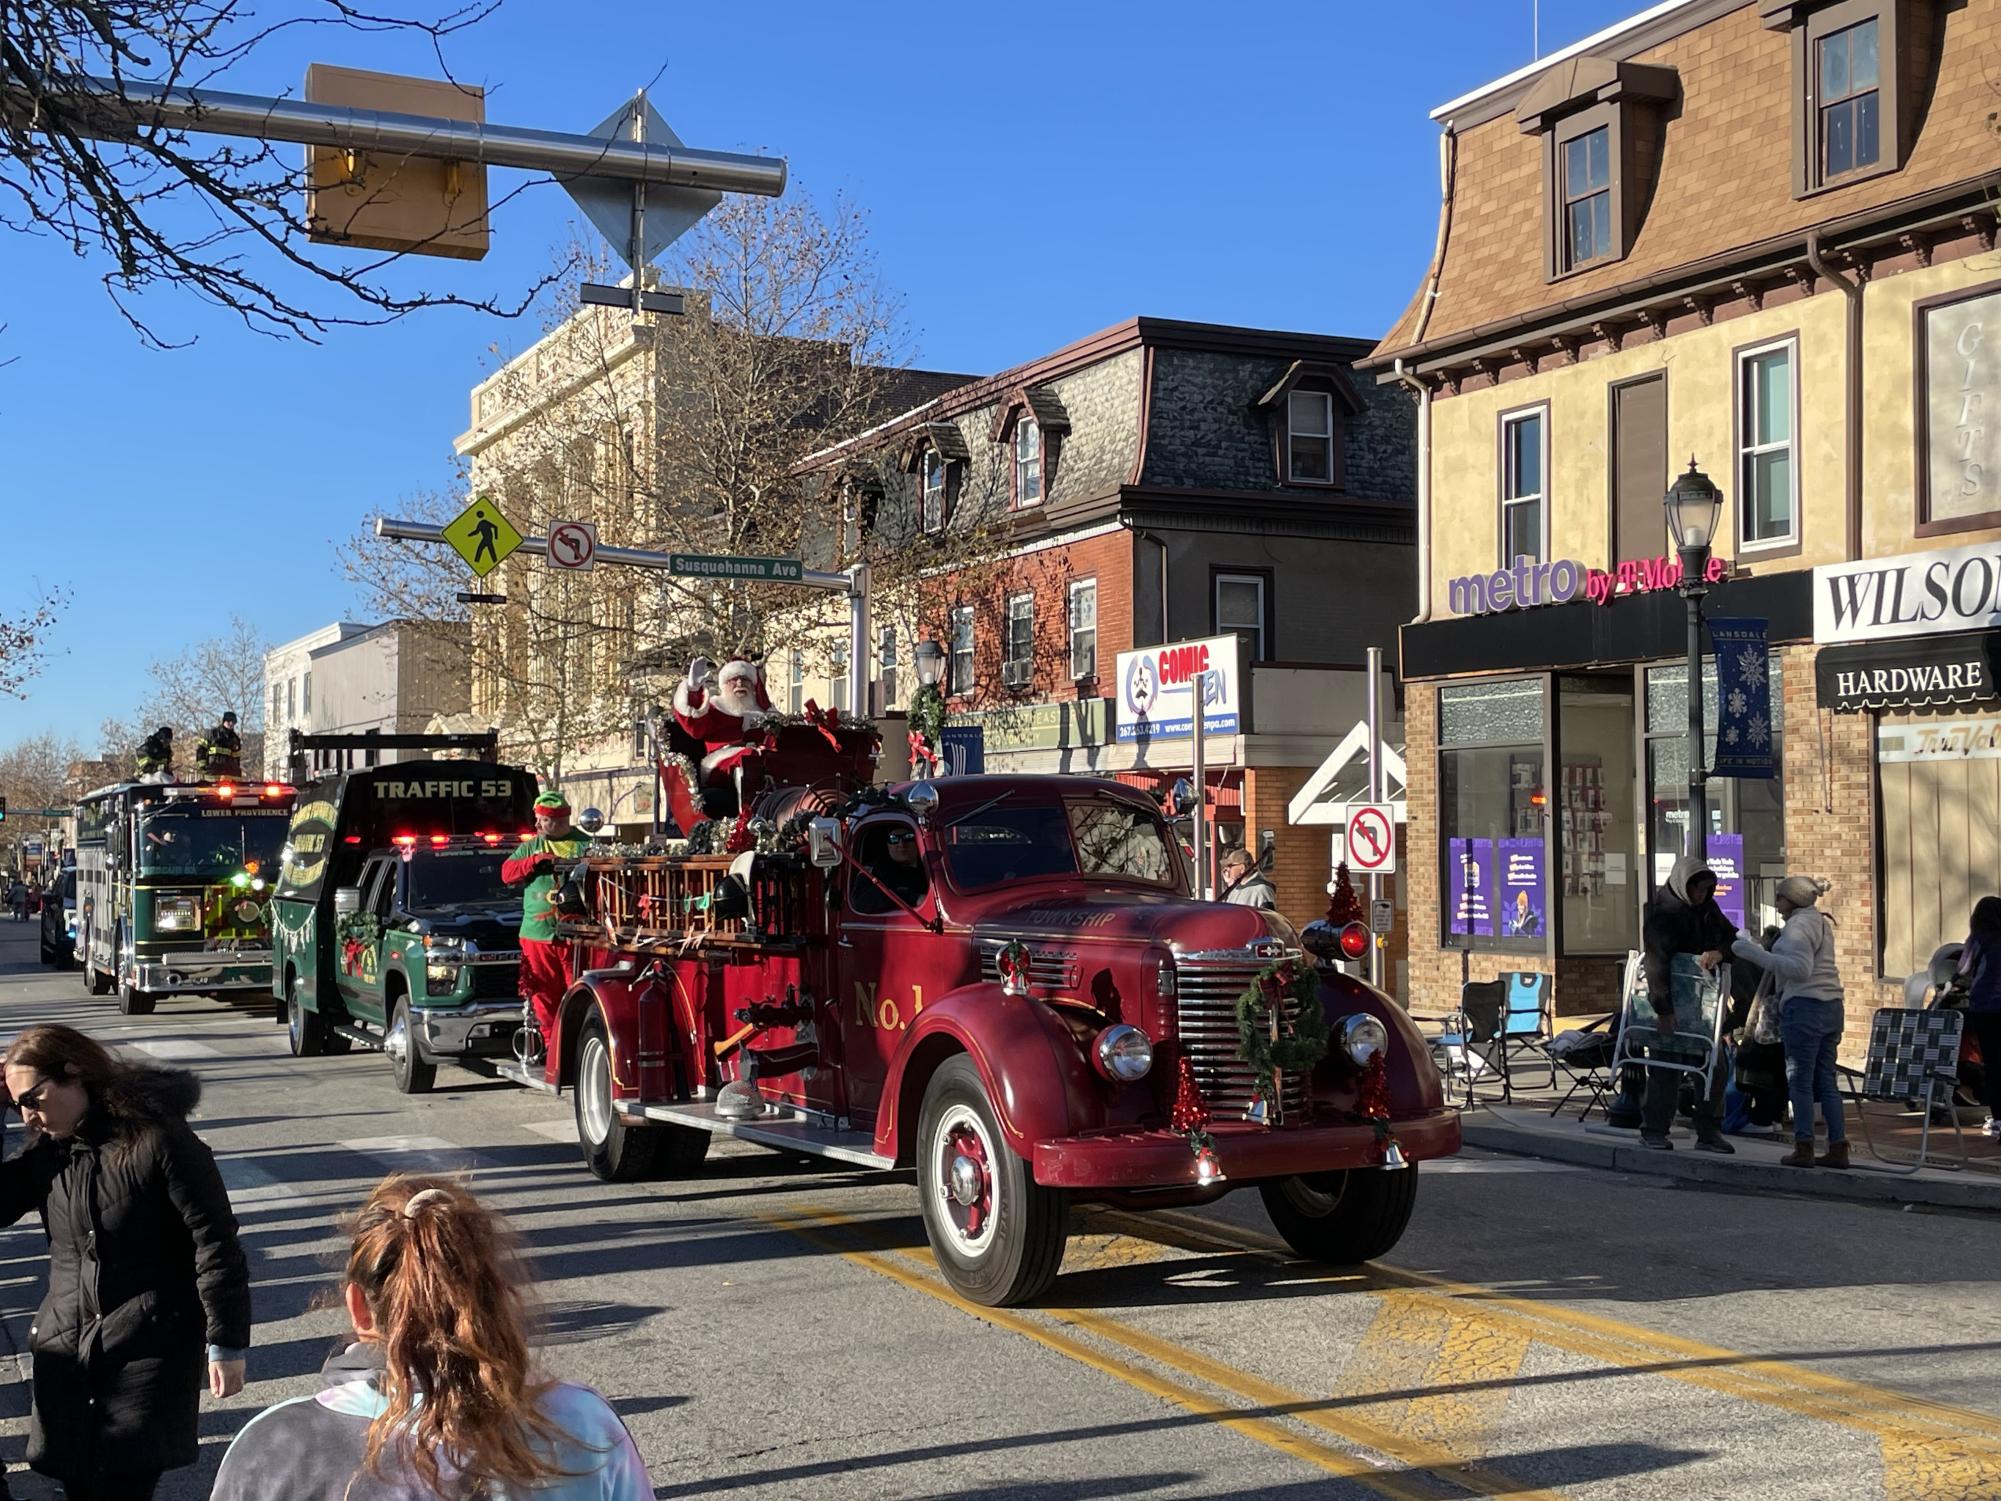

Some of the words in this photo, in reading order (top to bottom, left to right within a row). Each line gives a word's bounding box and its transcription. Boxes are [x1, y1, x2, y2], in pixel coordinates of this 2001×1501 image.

[1956, 322, 1984, 496] GIFTS
[676, 557, 766, 575] Susquehanna
[772, 562, 797, 577] Ave
[1449, 554, 1581, 615] metro
[1586, 568, 1614, 606] by
[1616, 554, 1722, 593] T-Moe
[1826, 555, 2001, 631] WILSO
[1712, 630, 1768, 638] LANSDALE
[1159, 644, 1210, 685] COMIC
[1836, 661, 1983, 697] HARDWARE
[373, 781, 474, 799] TRAFFIC
[481, 780, 512, 798] 53
[201, 809, 232, 818] LOWER
[235, 808, 289, 817] PROVIDENCE
[1026, 909, 1117, 928] TOWNSHIP
